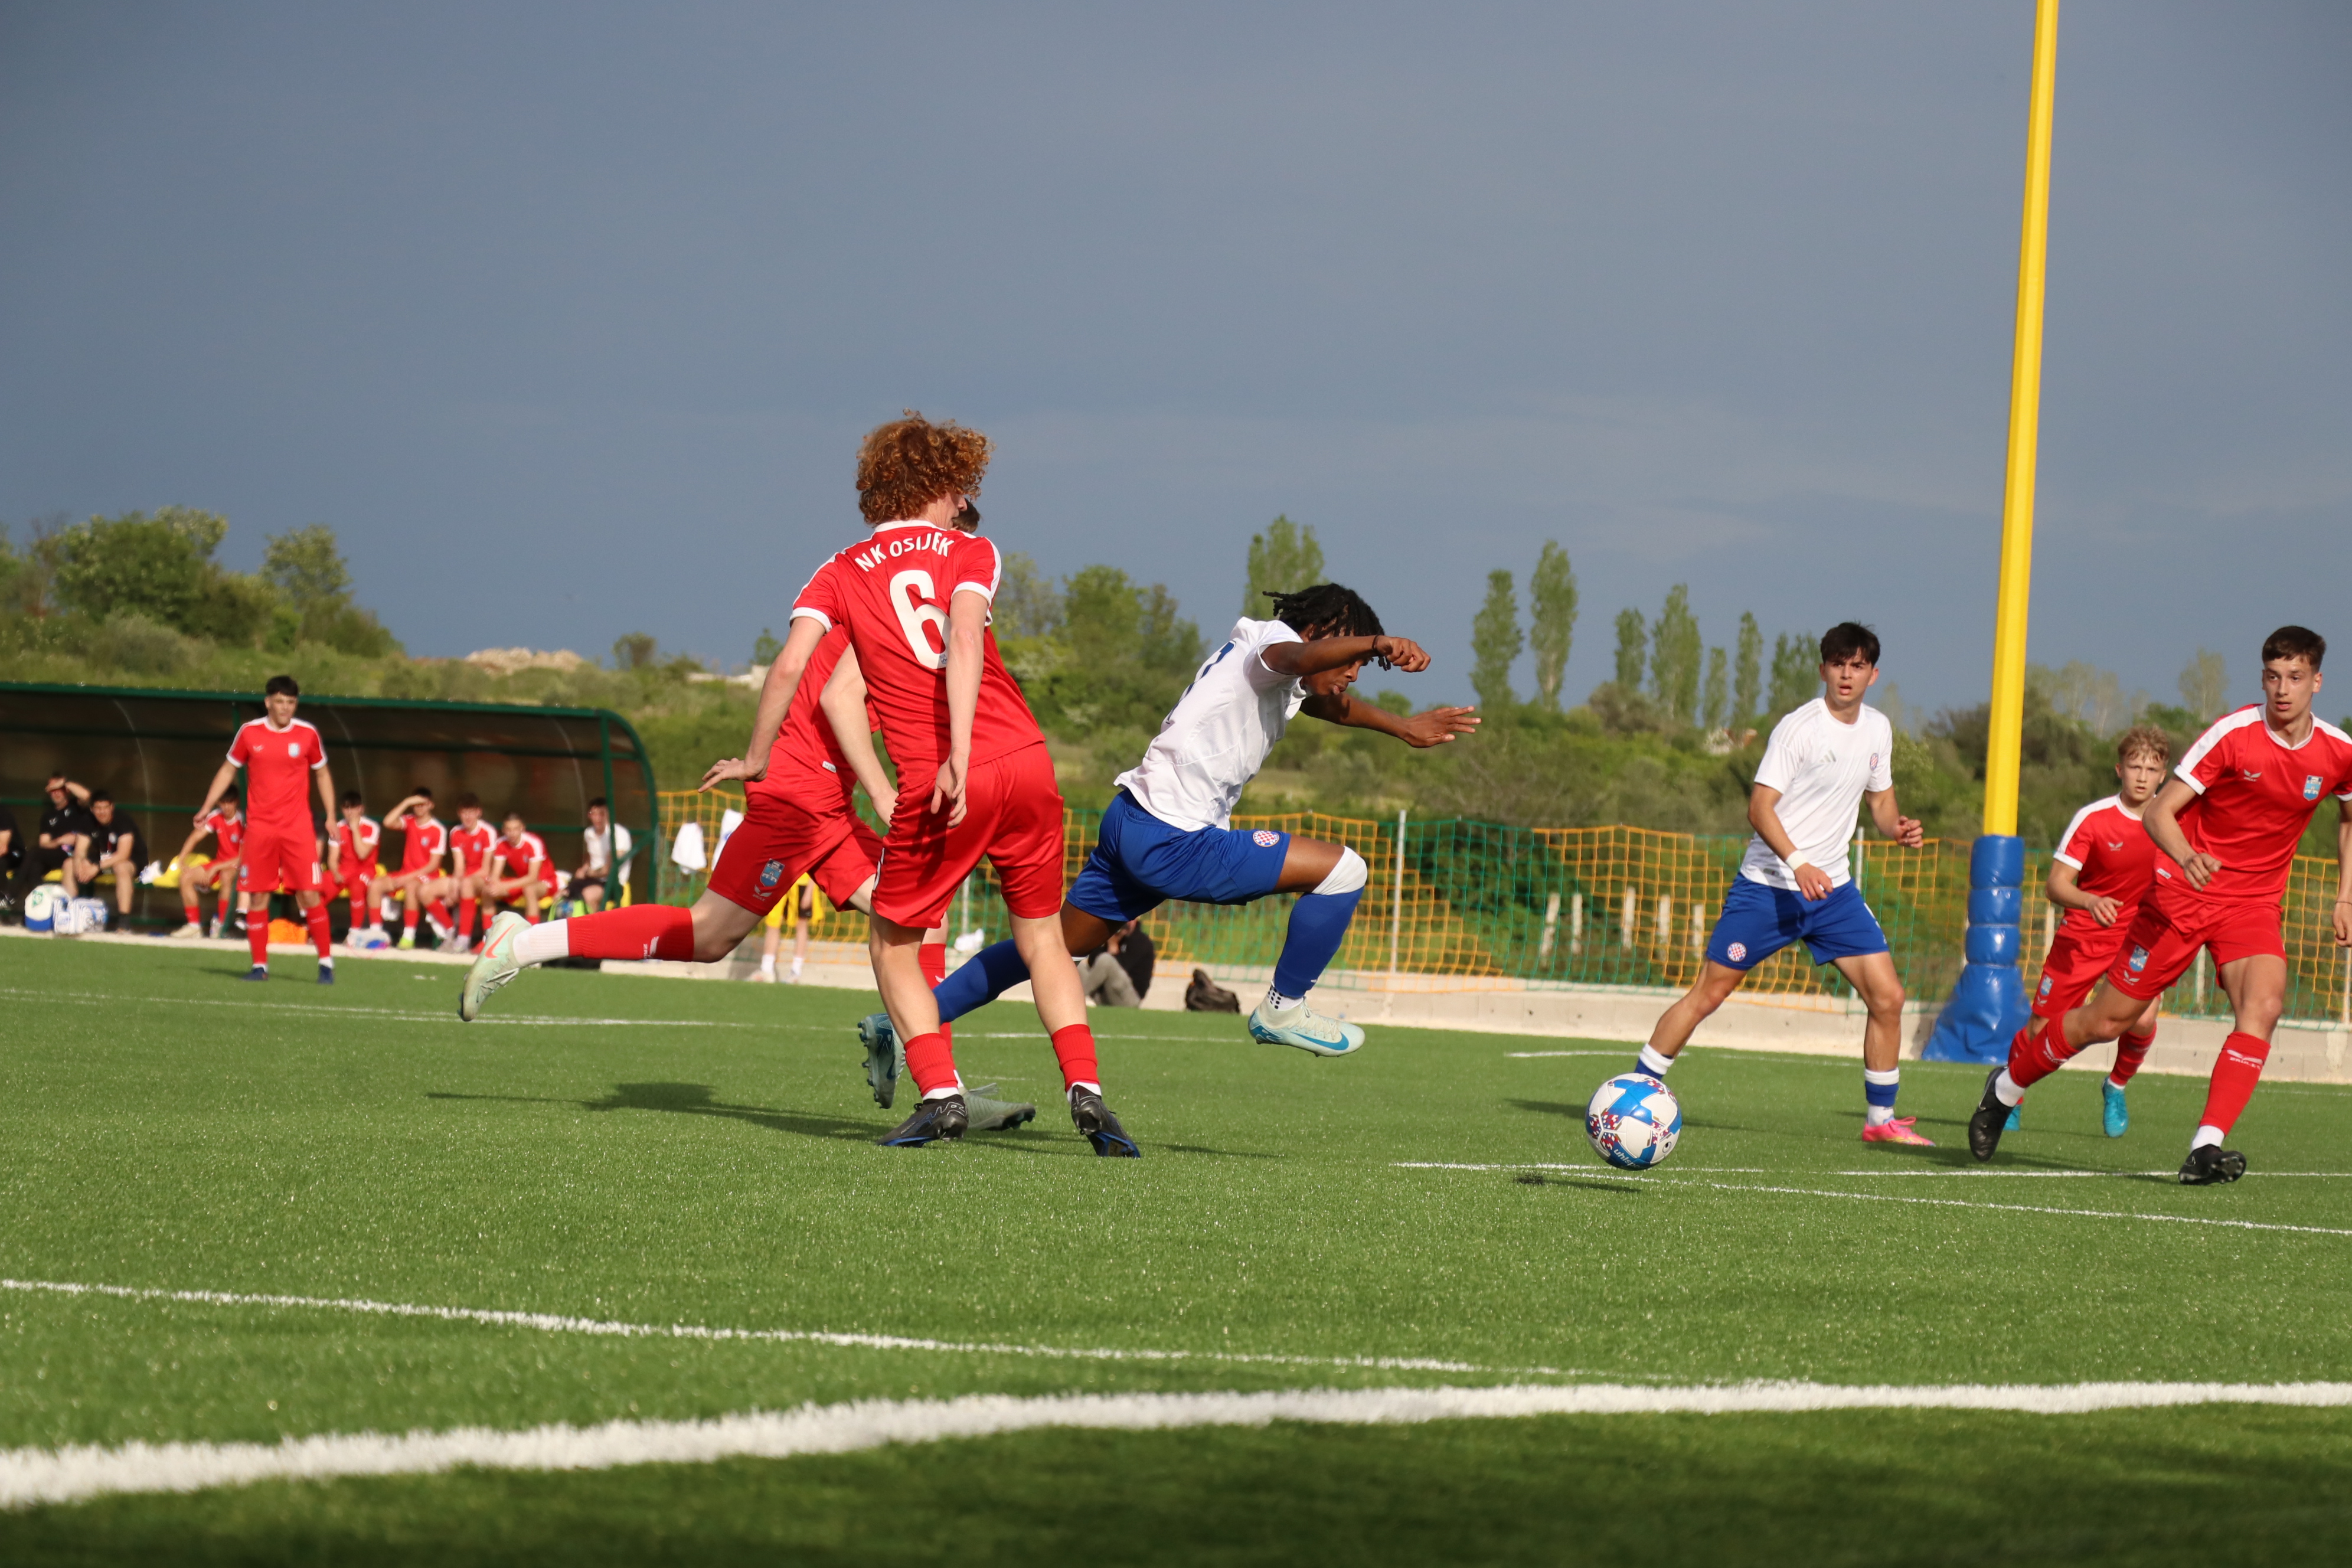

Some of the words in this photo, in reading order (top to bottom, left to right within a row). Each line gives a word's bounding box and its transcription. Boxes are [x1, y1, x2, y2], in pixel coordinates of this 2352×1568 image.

[854, 543, 887, 571] NK
[889, 532, 955, 557] OSIJEK
[890, 570, 951, 669] 6
